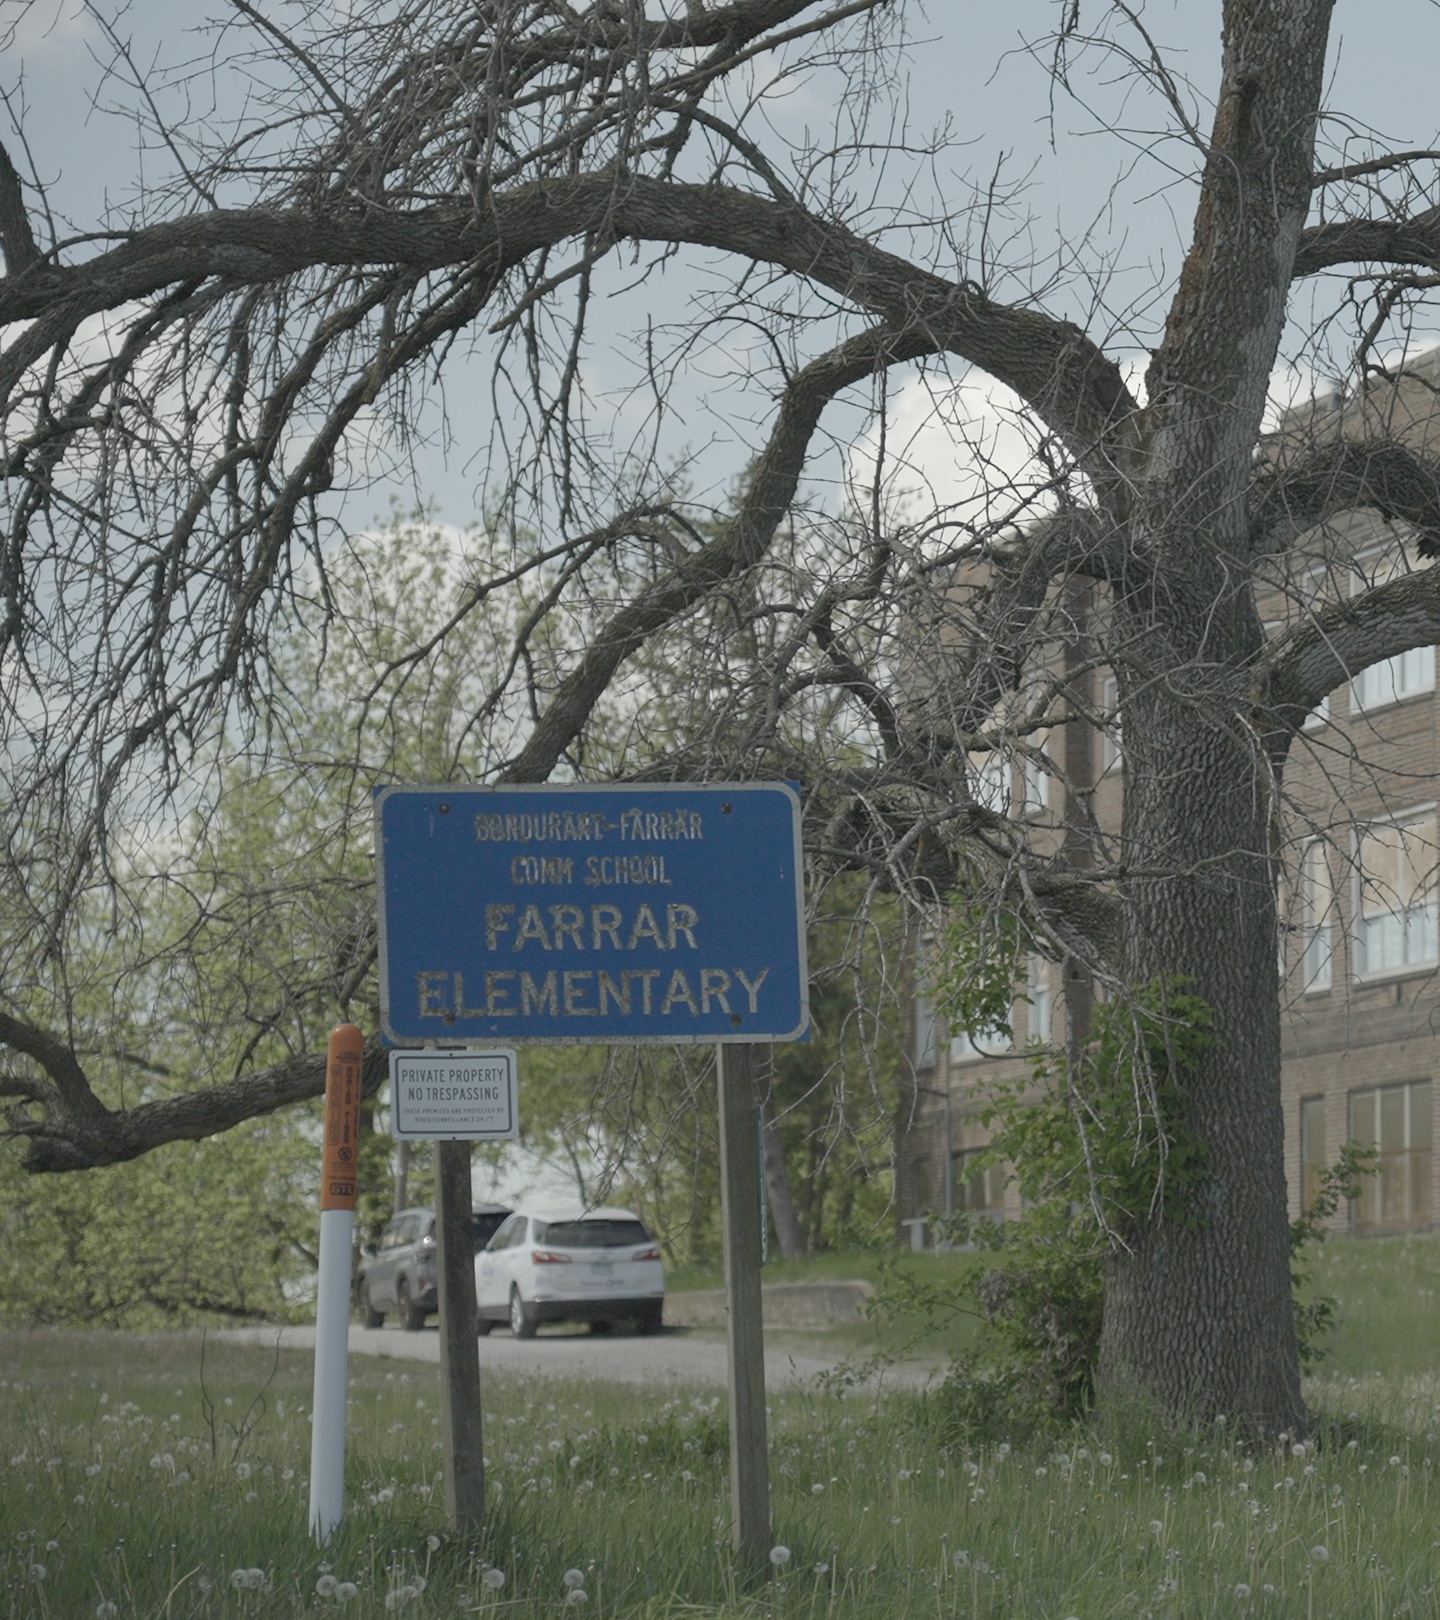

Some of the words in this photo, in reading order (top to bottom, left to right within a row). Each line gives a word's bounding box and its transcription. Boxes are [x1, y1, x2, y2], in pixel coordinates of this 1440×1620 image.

[475, 808, 703, 842] BONDURANT-FARRAR
[511, 856, 574, 886] COMM
[585, 855, 672, 886] SCHOOL
[485, 903, 699, 951] FARRAR
[415, 967, 770, 1019] ELEMENTARY
[402, 1069, 445, 1082] PRIVATE
[449, 1068, 504, 1082] PROPERTY
[408, 1087, 423, 1100] NO
[426, 1086, 499, 1100] TRESPASSING
[476, 1115, 494, 1123] 24/7
